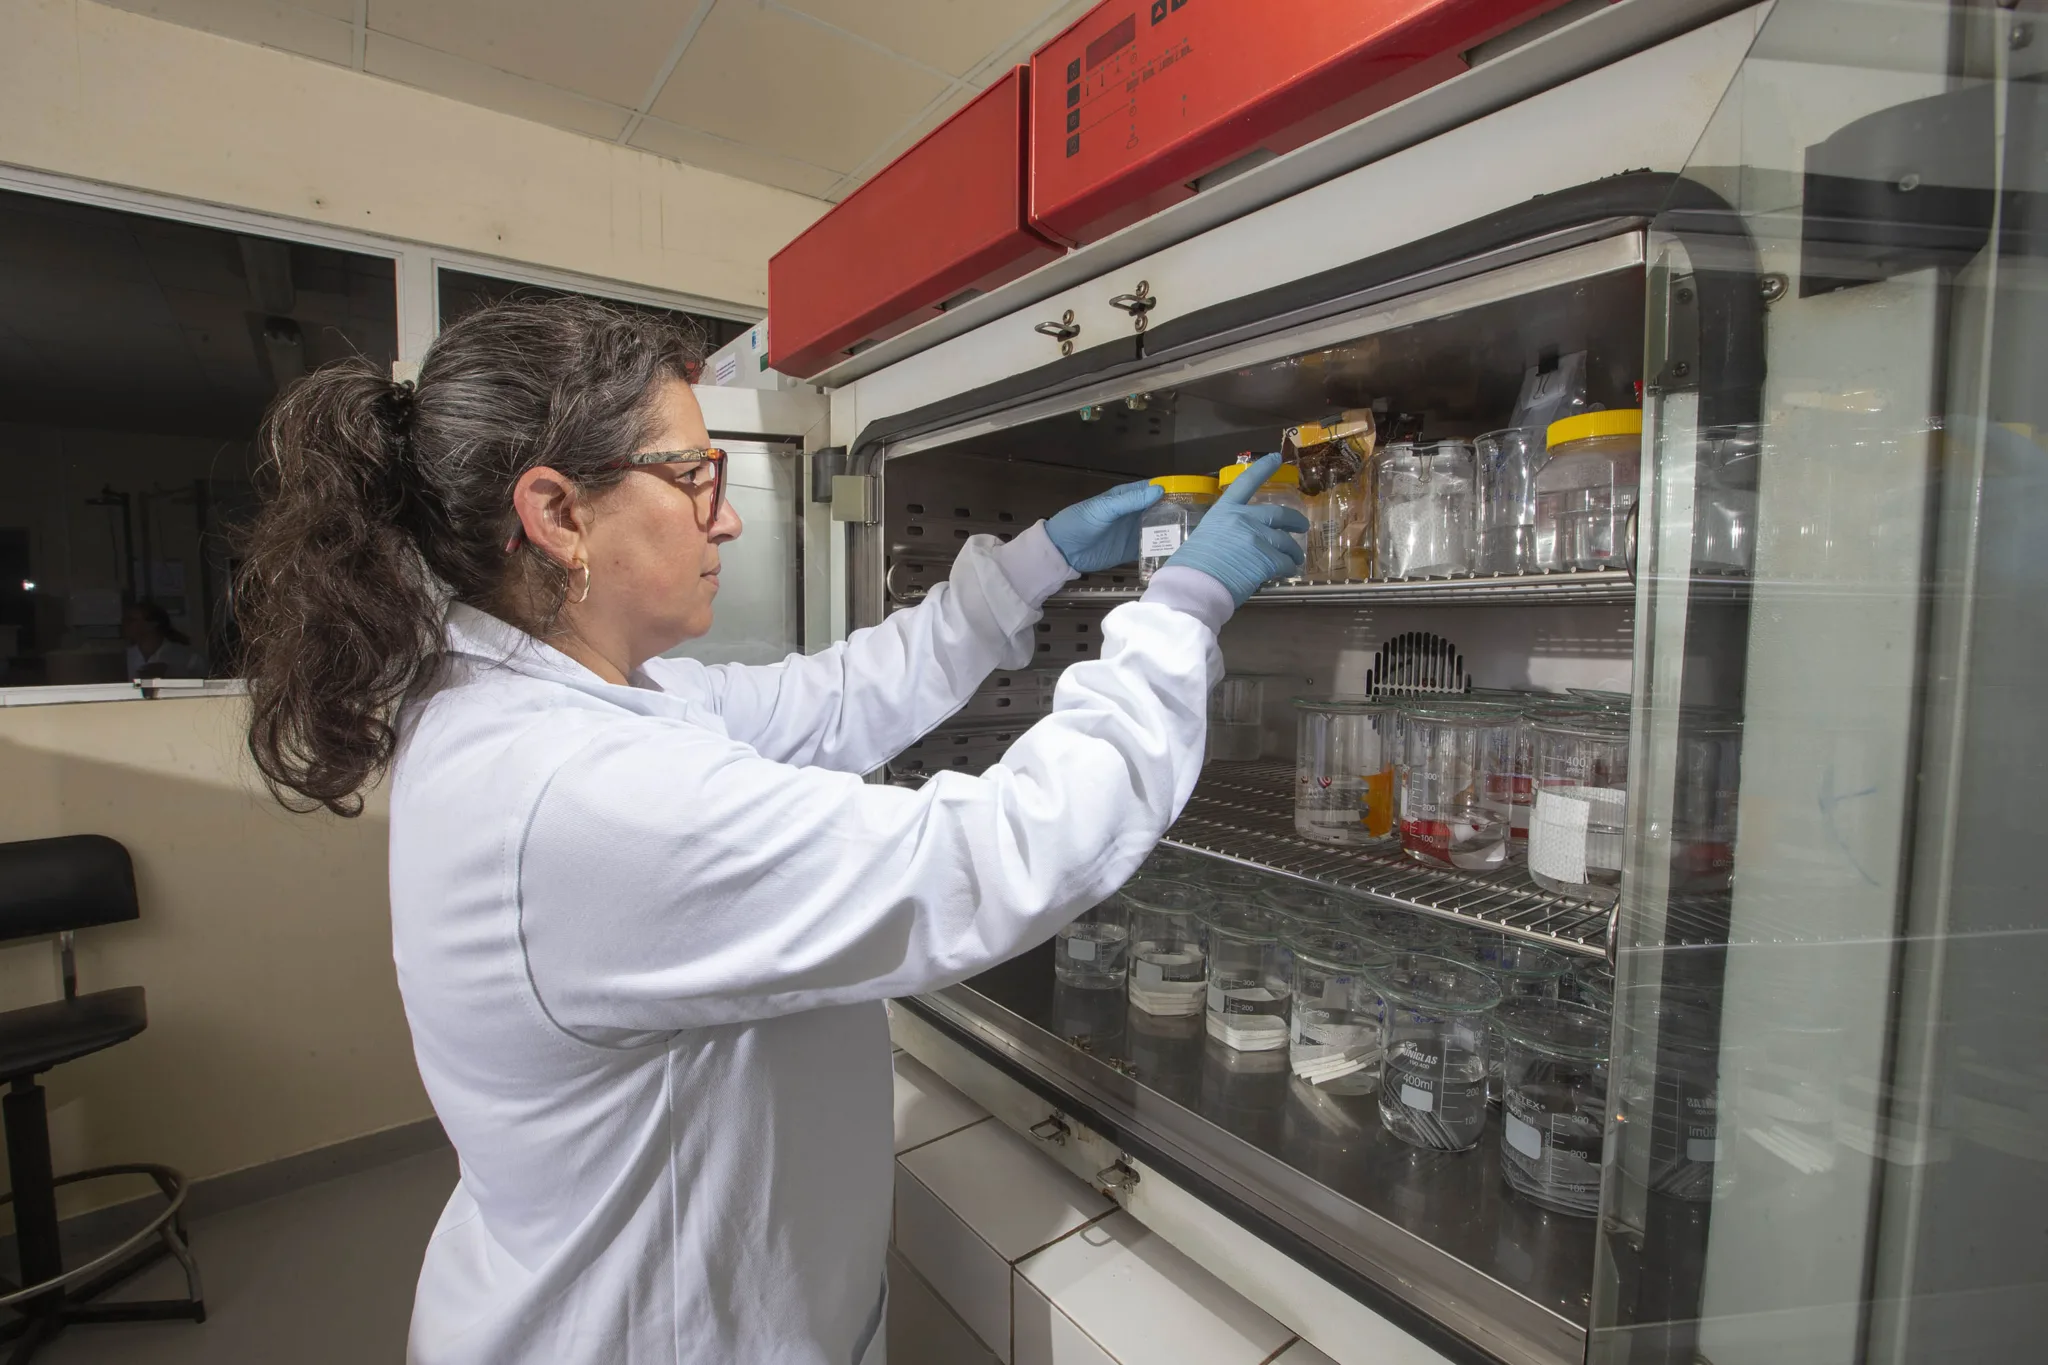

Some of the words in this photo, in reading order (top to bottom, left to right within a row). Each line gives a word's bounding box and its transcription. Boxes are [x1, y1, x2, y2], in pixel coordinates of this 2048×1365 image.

[1424, 772, 1437, 781] 300
[1422, 803, 1436, 813] 200
[1420, 833, 1434, 844] 100
[1242, 979, 1255, 987] 300
[1241, 1003, 1254, 1012] 200
[1317, 1010, 1330, 1019] 300
[1402, 1049, 1439, 1065] UNIGLAS
[1402, 1073, 1433, 1091] 400ml
[1465, 1086, 1480, 1097] 200
[1465, 1116, 1477, 1125] 100
[1523, 1113, 1534, 1125] ml
[1571, 1115, 1589, 1124] 300
[1570, 1149, 1588, 1159] 200
[1569, 1183, 1586, 1193] 100
